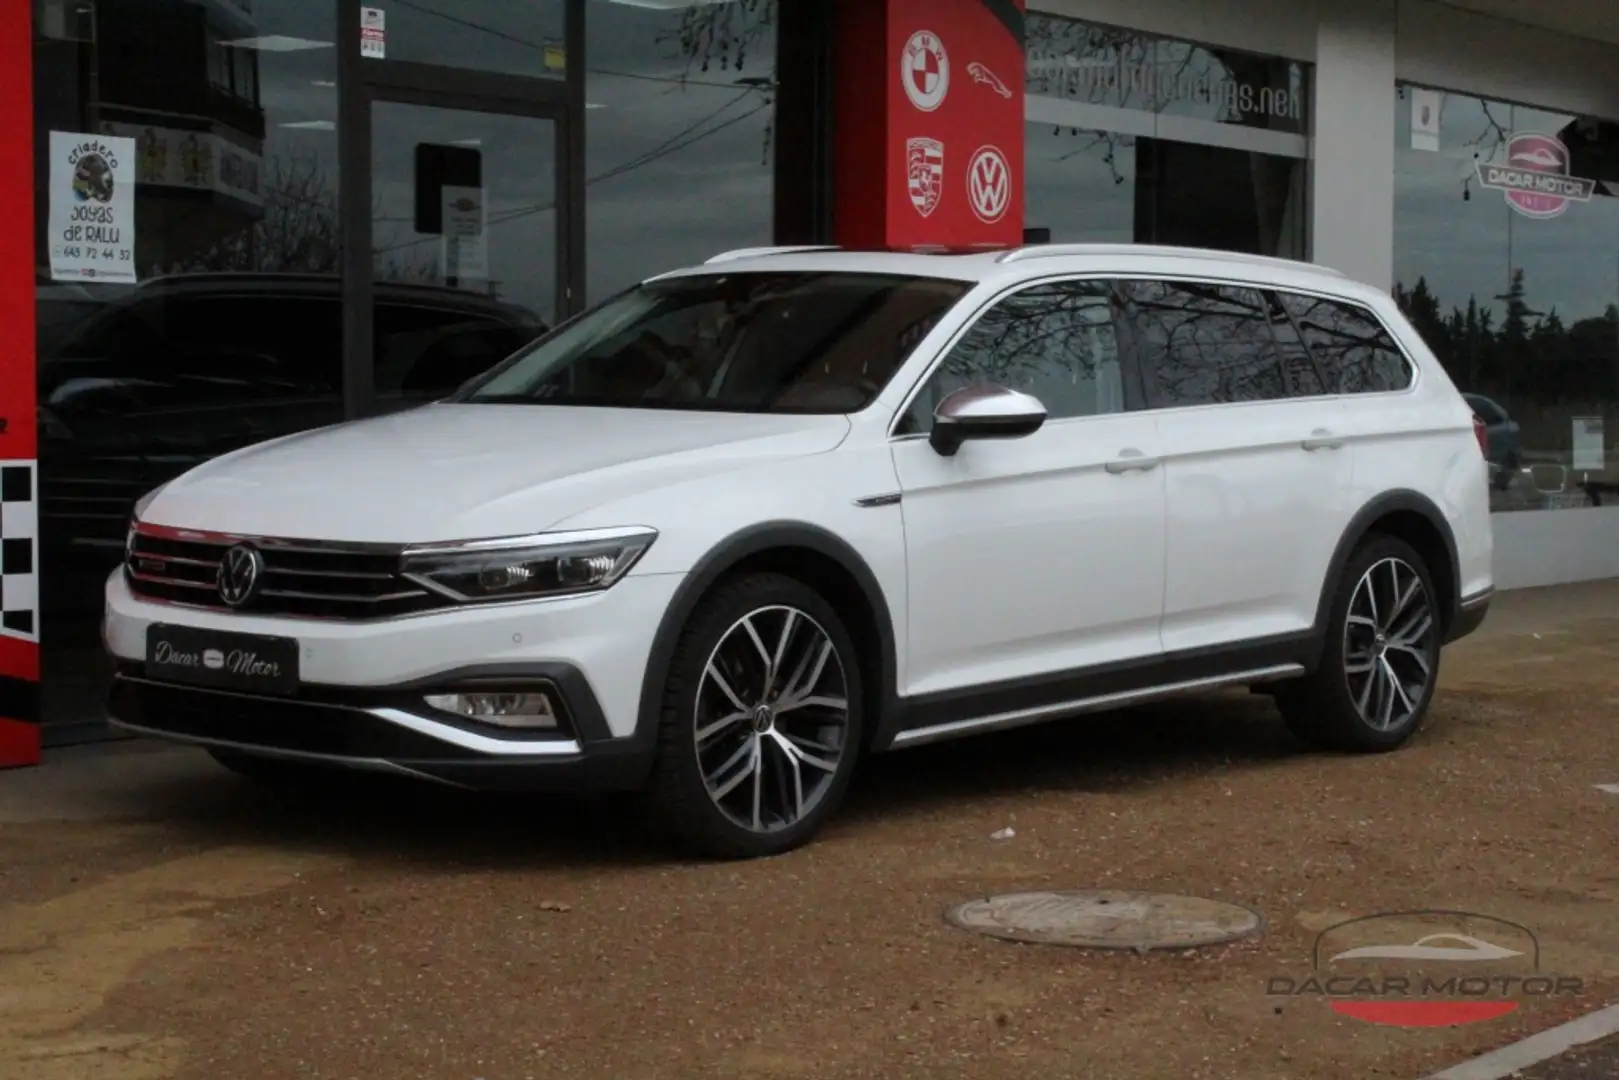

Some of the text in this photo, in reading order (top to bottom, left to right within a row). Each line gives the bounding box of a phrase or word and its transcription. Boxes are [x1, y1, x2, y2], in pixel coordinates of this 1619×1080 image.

[68, 140, 118, 169] criadero
[1488, 169, 1584, 196] DACAR MOTOR
[63, 225, 120, 244] de RALU
